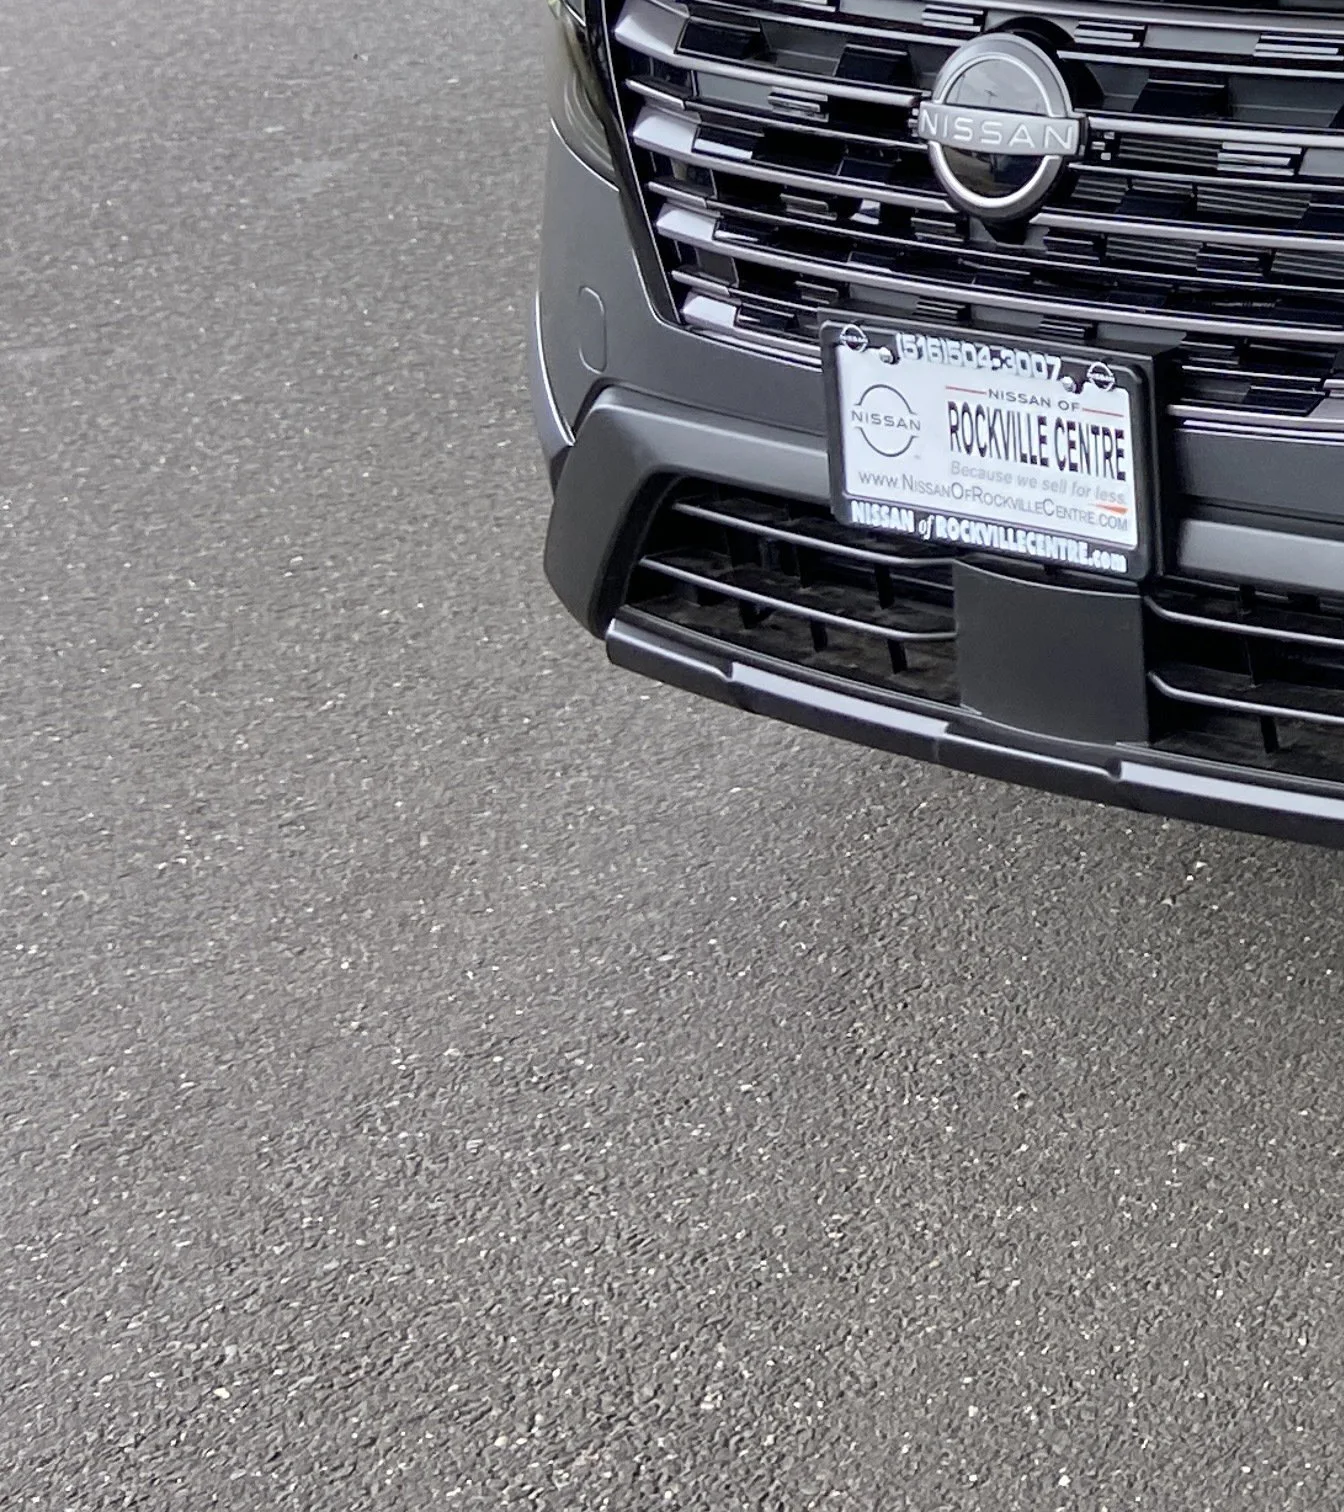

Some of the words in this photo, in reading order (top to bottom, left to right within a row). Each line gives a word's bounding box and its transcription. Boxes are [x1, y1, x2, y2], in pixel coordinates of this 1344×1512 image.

[920, 108, 1073, 150] NISSAN
[851, 409, 921, 432] NISSAN
[988, 388, 1051, 408] NISSAN
[1058, 399, 1081, 413] OF
[947, 400, 1049, 468] ROCKVILLE
[1053, 416, 1127, 482] CENTRE
[950, 460, 1013, 485] Because
[1016, 474, 1038, 489] we
[1041, 476, 1068, 495] sell
[1072, 481, 1093, 499] for
[850, 500, 914, 534] NISSAN
[918, 515, 934, 541] of
